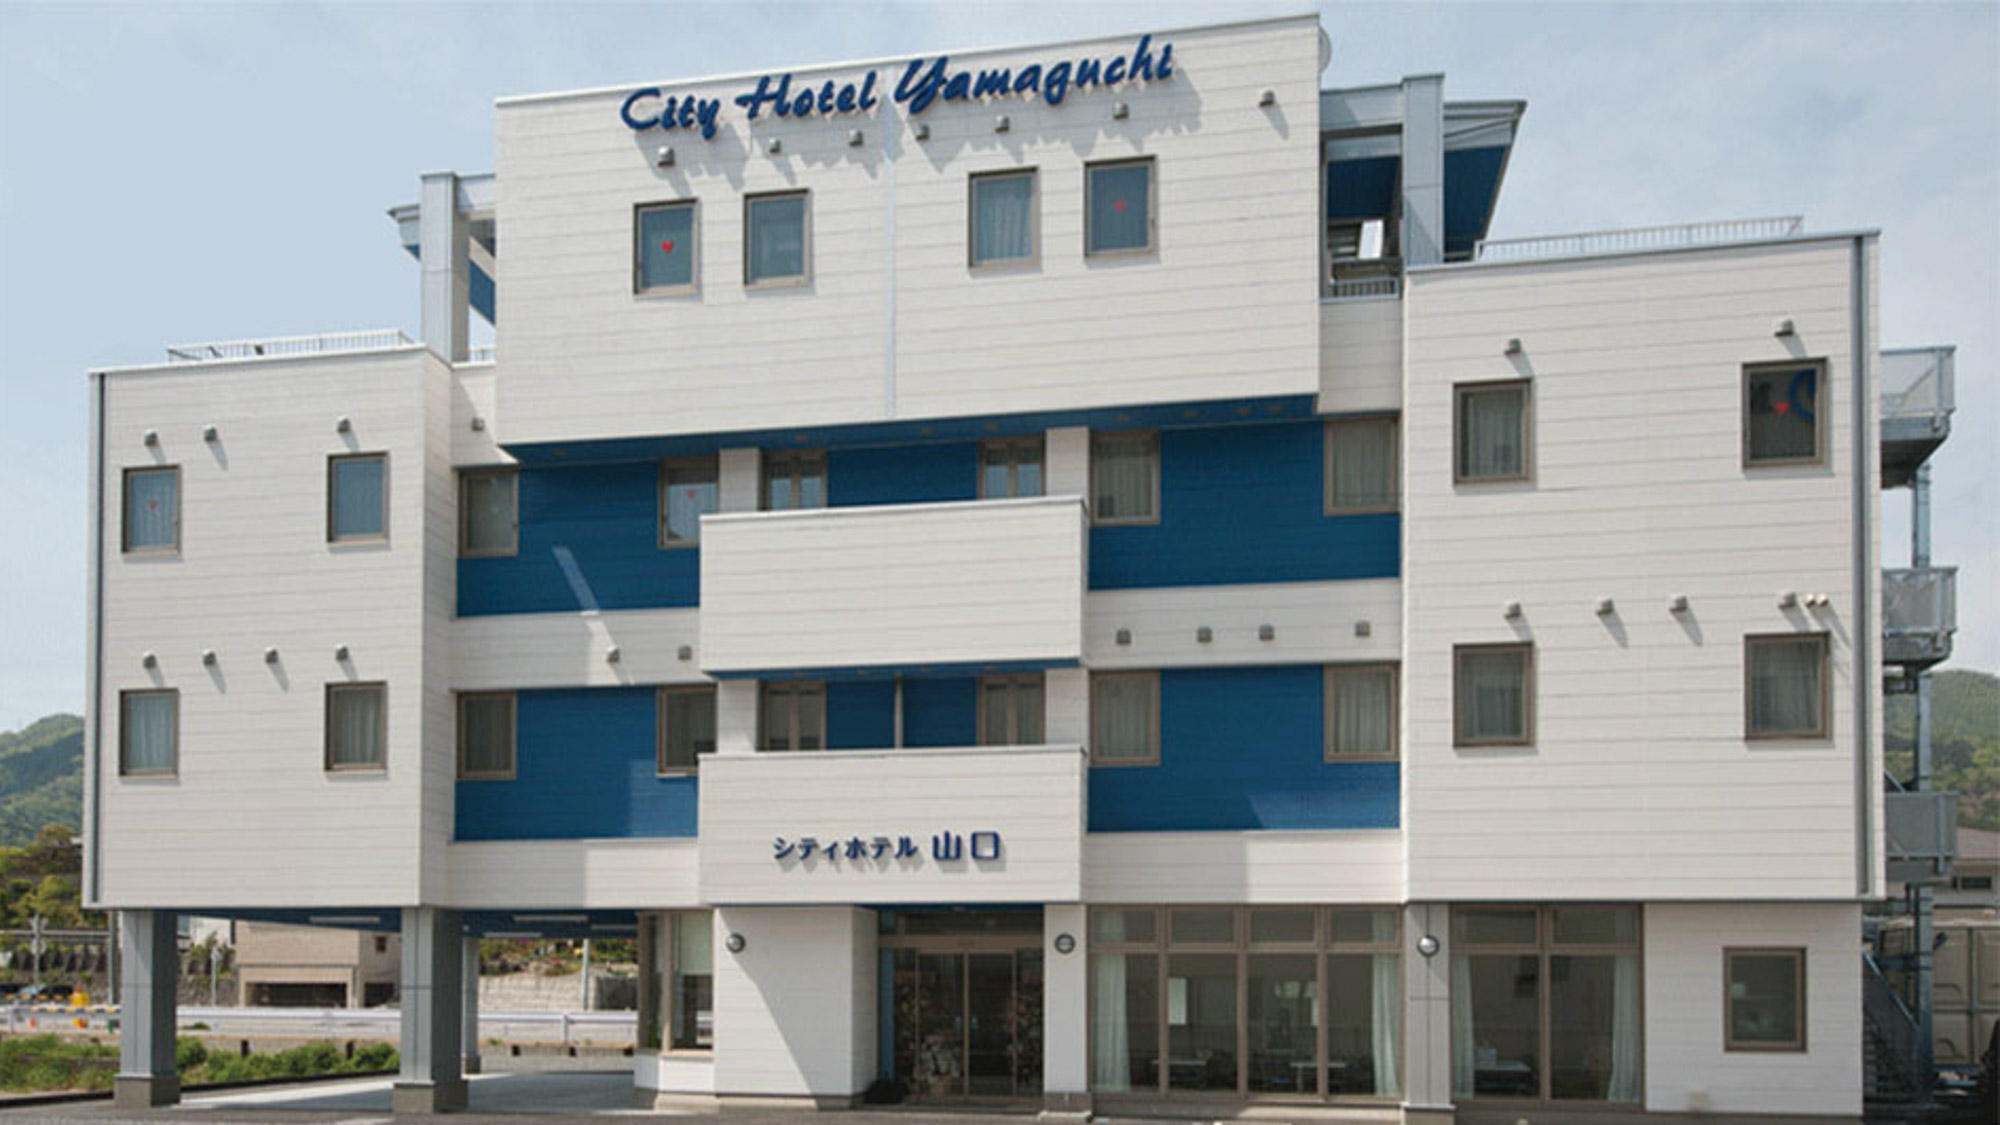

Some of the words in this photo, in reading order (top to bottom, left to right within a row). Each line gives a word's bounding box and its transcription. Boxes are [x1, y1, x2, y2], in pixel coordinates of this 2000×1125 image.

[620, 86, 720, 140] City
[735, 71, 876, 119] Hotel
[894, 34, 1173, 115] Yamaguchi
[773, 836, 919, 861] シティホテル
[932, 830, 1001, 861] 山口
